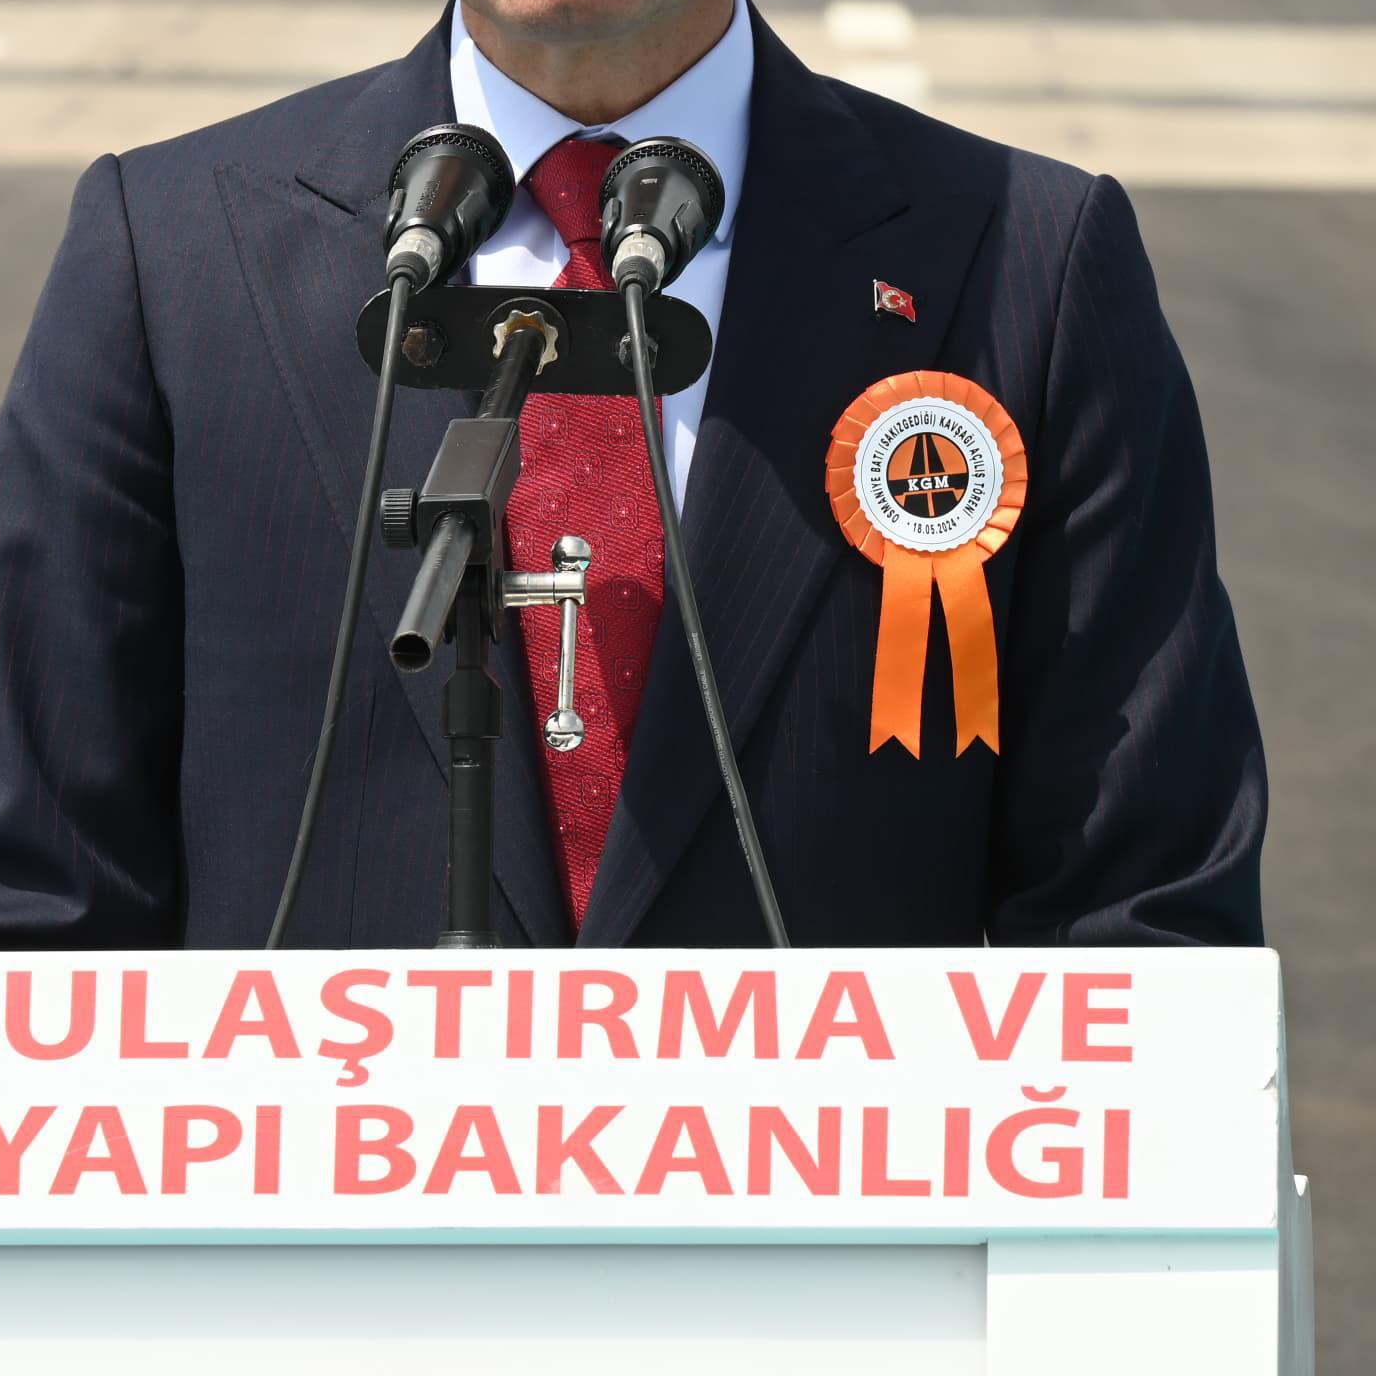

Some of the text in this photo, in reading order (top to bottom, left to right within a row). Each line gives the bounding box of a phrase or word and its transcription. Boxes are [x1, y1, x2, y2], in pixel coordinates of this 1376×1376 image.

[939, 416, 975, 447] KAVŞAĞI
[870, 450, 884, 472] BATI
[969, 447, 985, 478] AÇILIŞ
[907, 475, 949, 491] KGM
[870, 476, 899, 523] OSMANİYE
[963, 482, 985, 519] TÖRENİ
[913, 518, 956, 534] 18.05.2024
[5, 969, 895, 1088] ULAŞTIRMA
[947, 971, 1133, 1063] VE
[333, 1085, 1132, 1200] BAKANLIĞI
